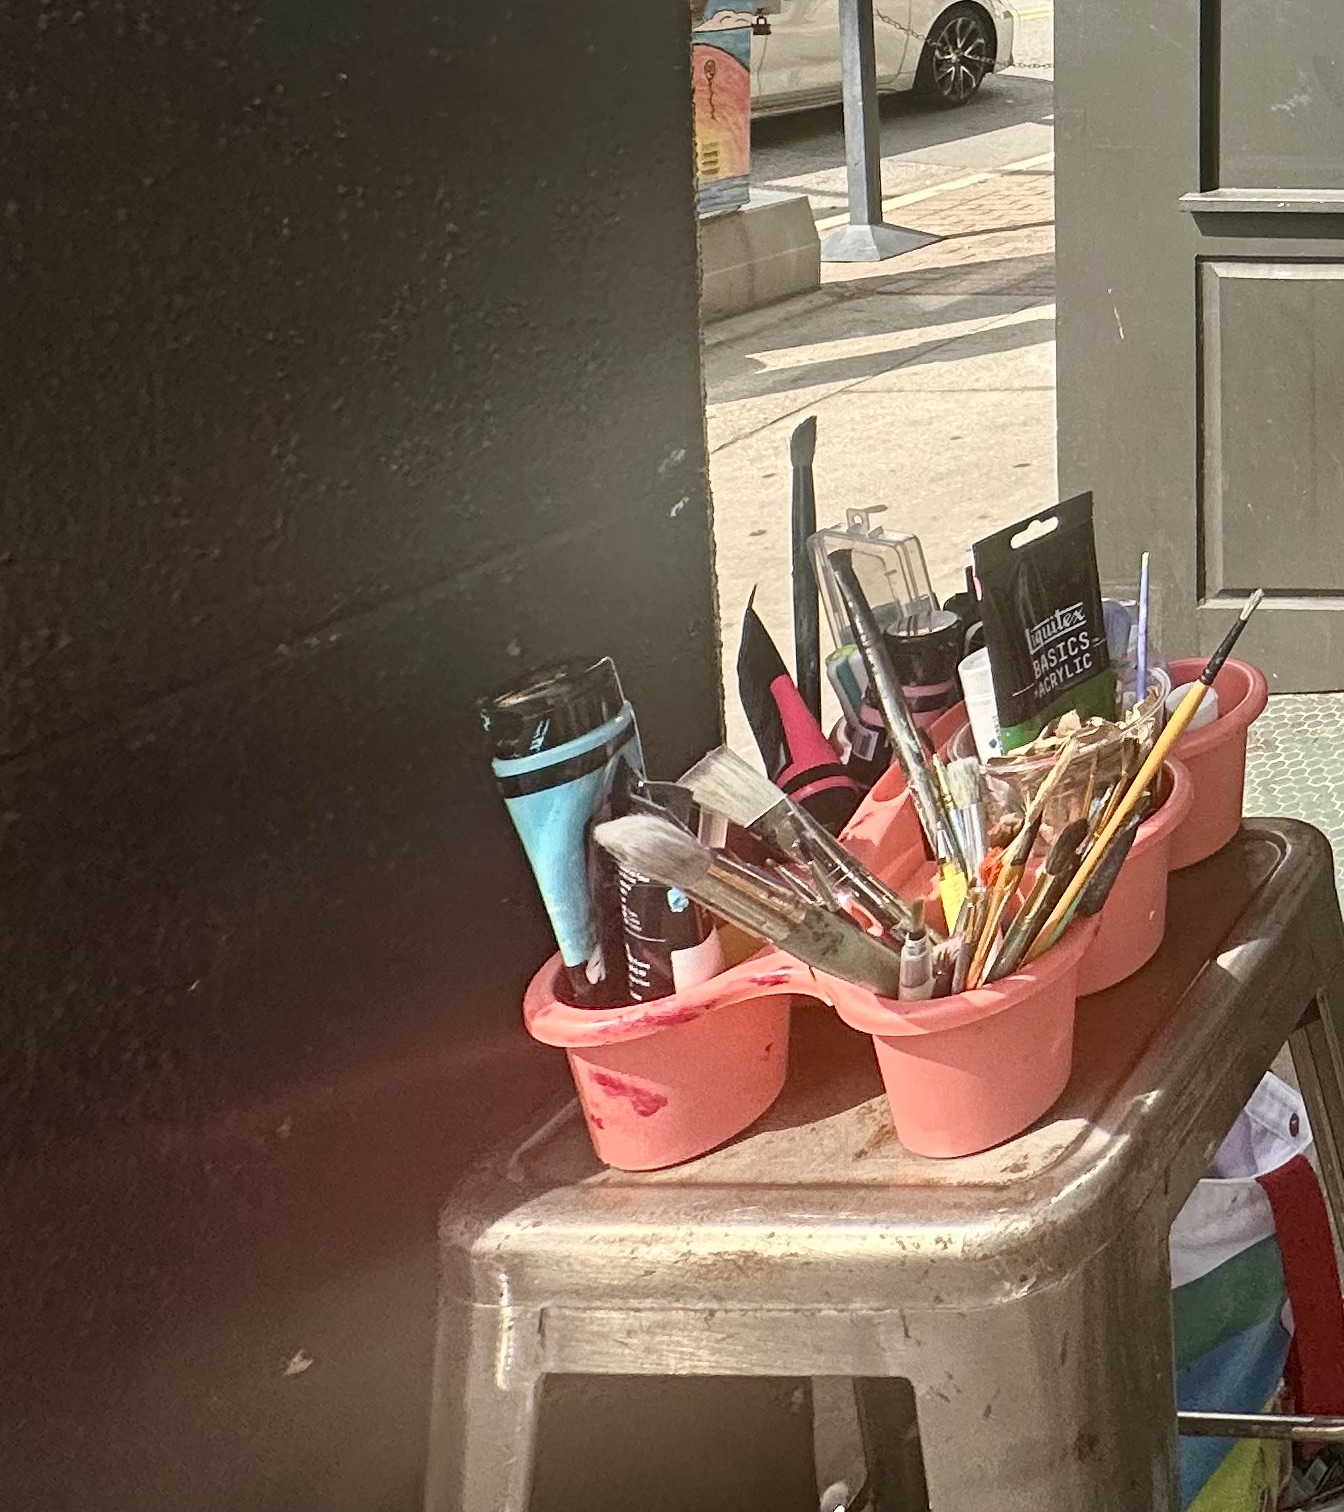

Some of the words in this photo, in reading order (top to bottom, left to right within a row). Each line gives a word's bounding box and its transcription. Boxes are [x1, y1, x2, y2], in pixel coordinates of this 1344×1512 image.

[1025, 607, 1086, 655] Liquitex
[1032, 631, 1090, 679] BASICS
[1038, 653, 1092, 698] ACRYLIC
